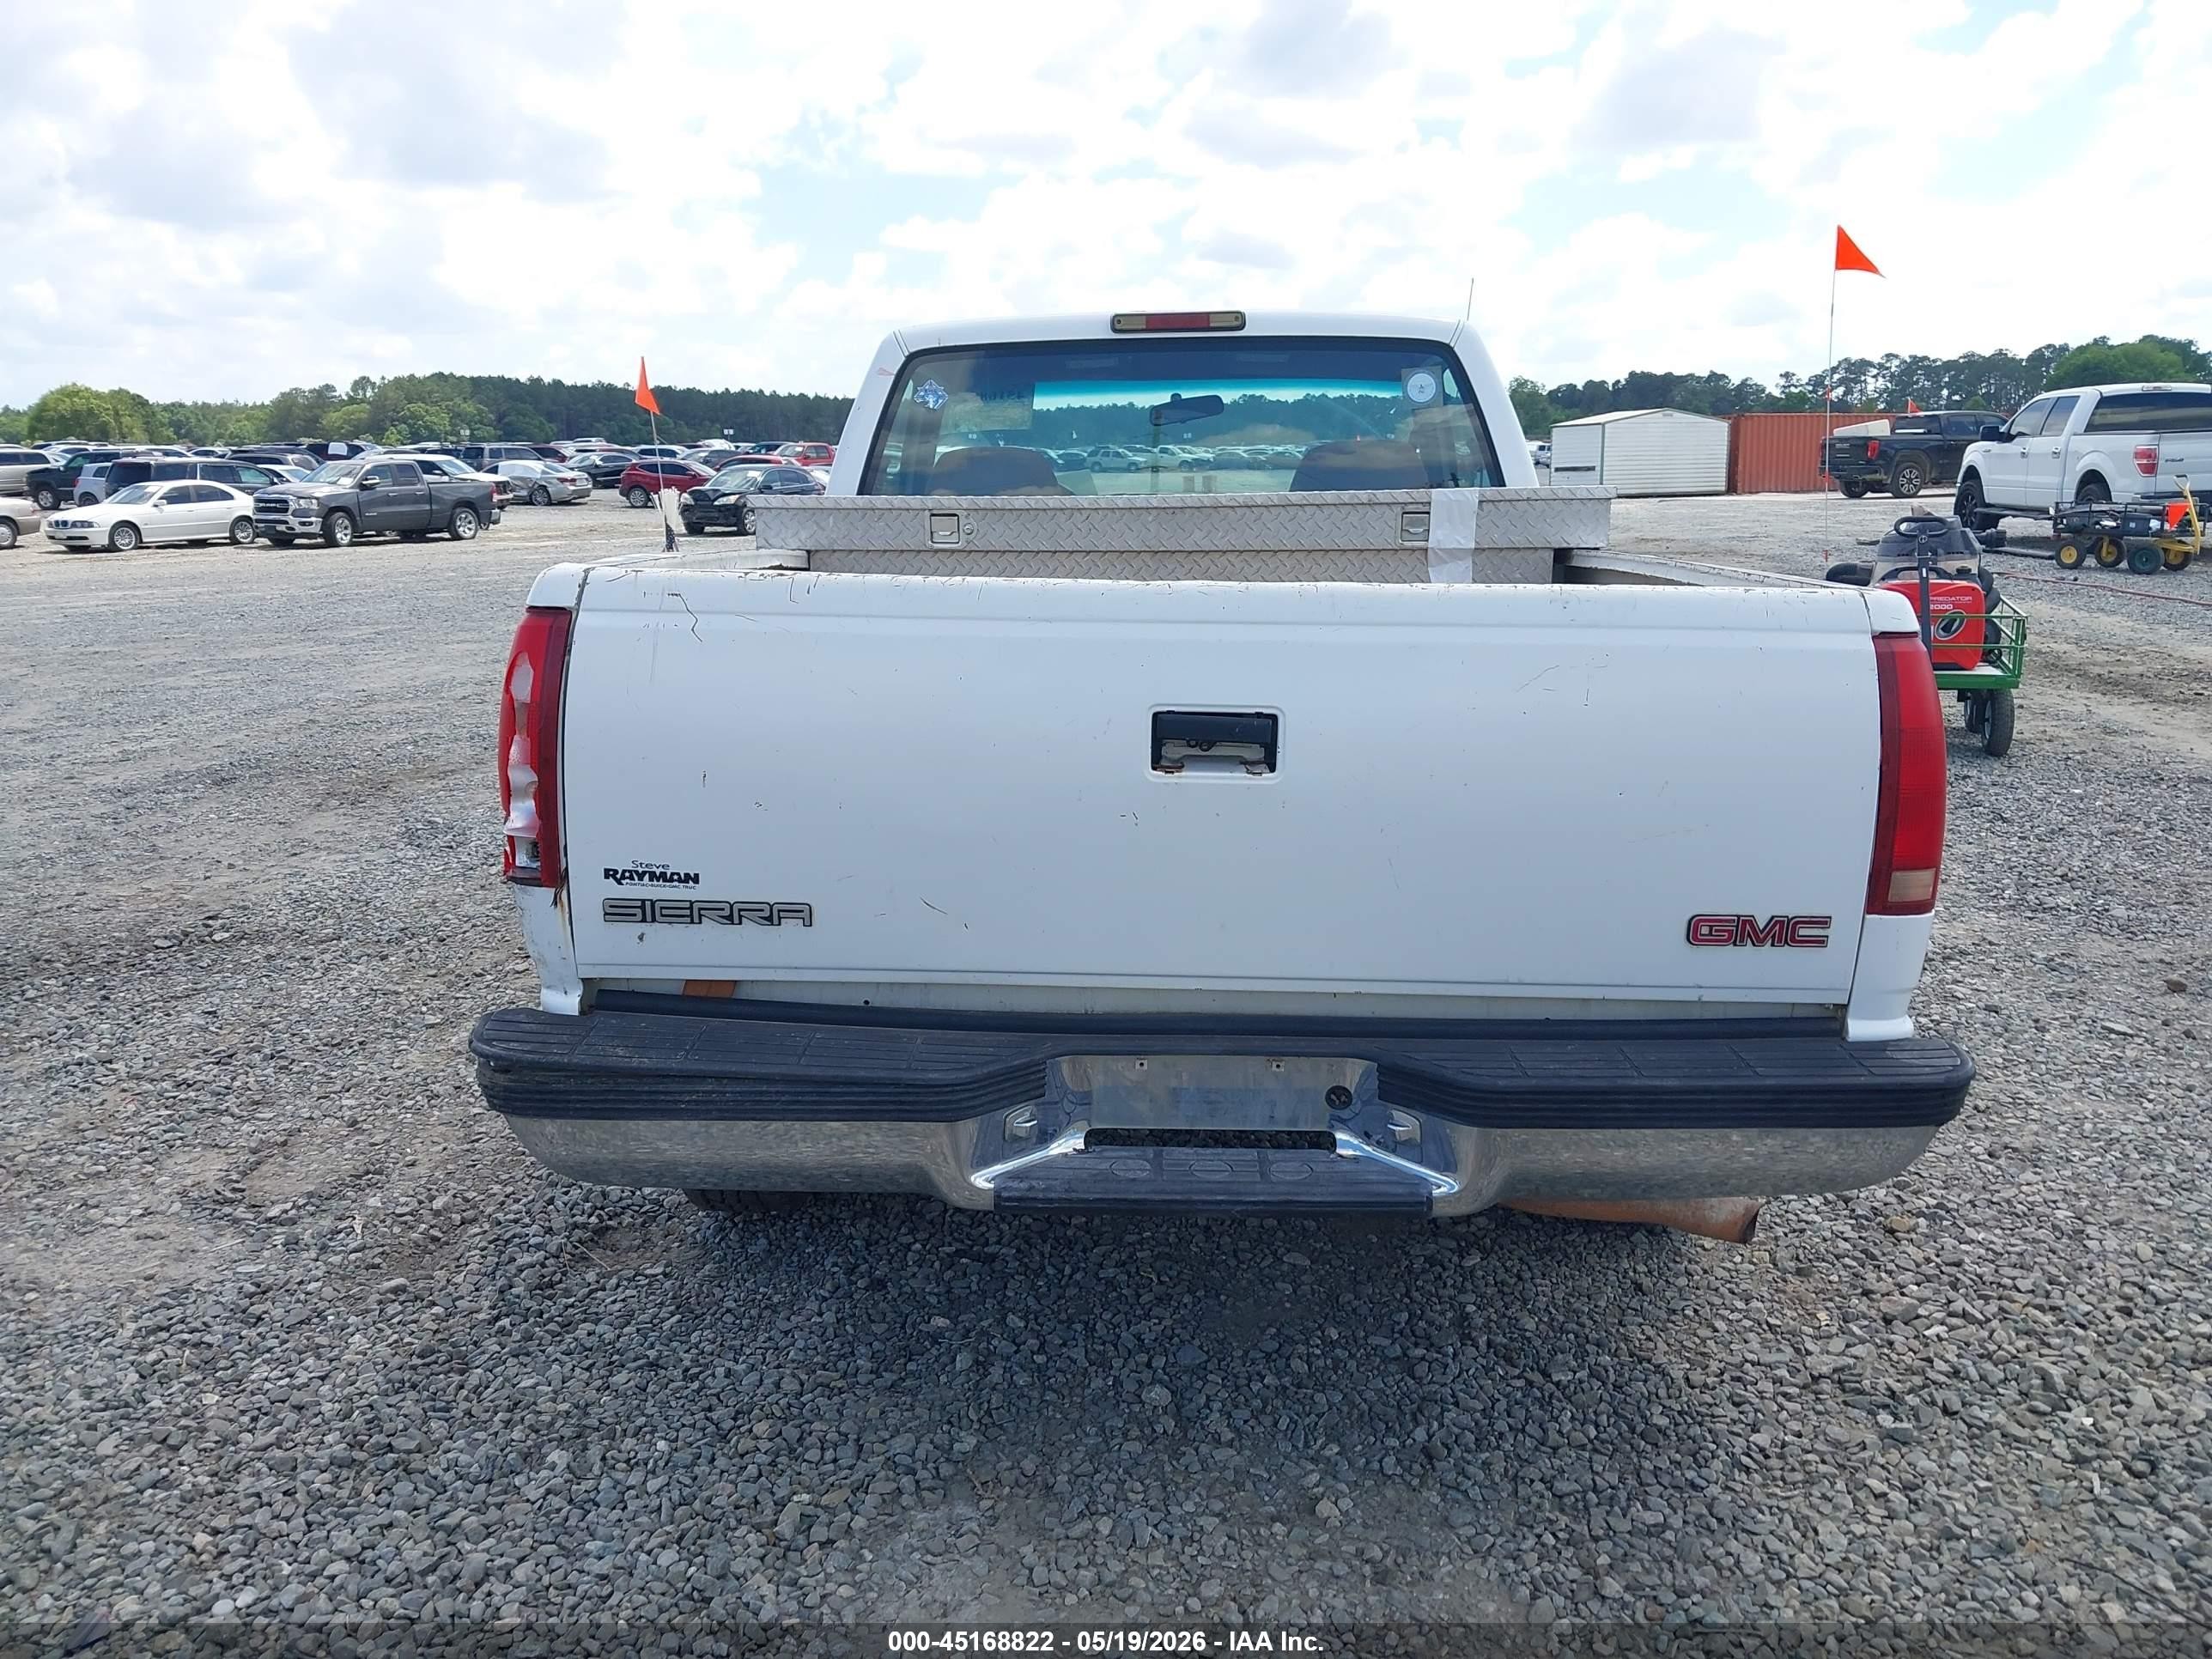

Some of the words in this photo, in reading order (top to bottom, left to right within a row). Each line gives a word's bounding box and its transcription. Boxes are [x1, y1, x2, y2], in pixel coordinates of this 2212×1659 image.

[603, 867, 700, 885] RAYMAN
[631, 860, 670, 870] Steve
[603, 898, 812, 927] SIERRA
[1686, 915, 1832, 948] GMC
